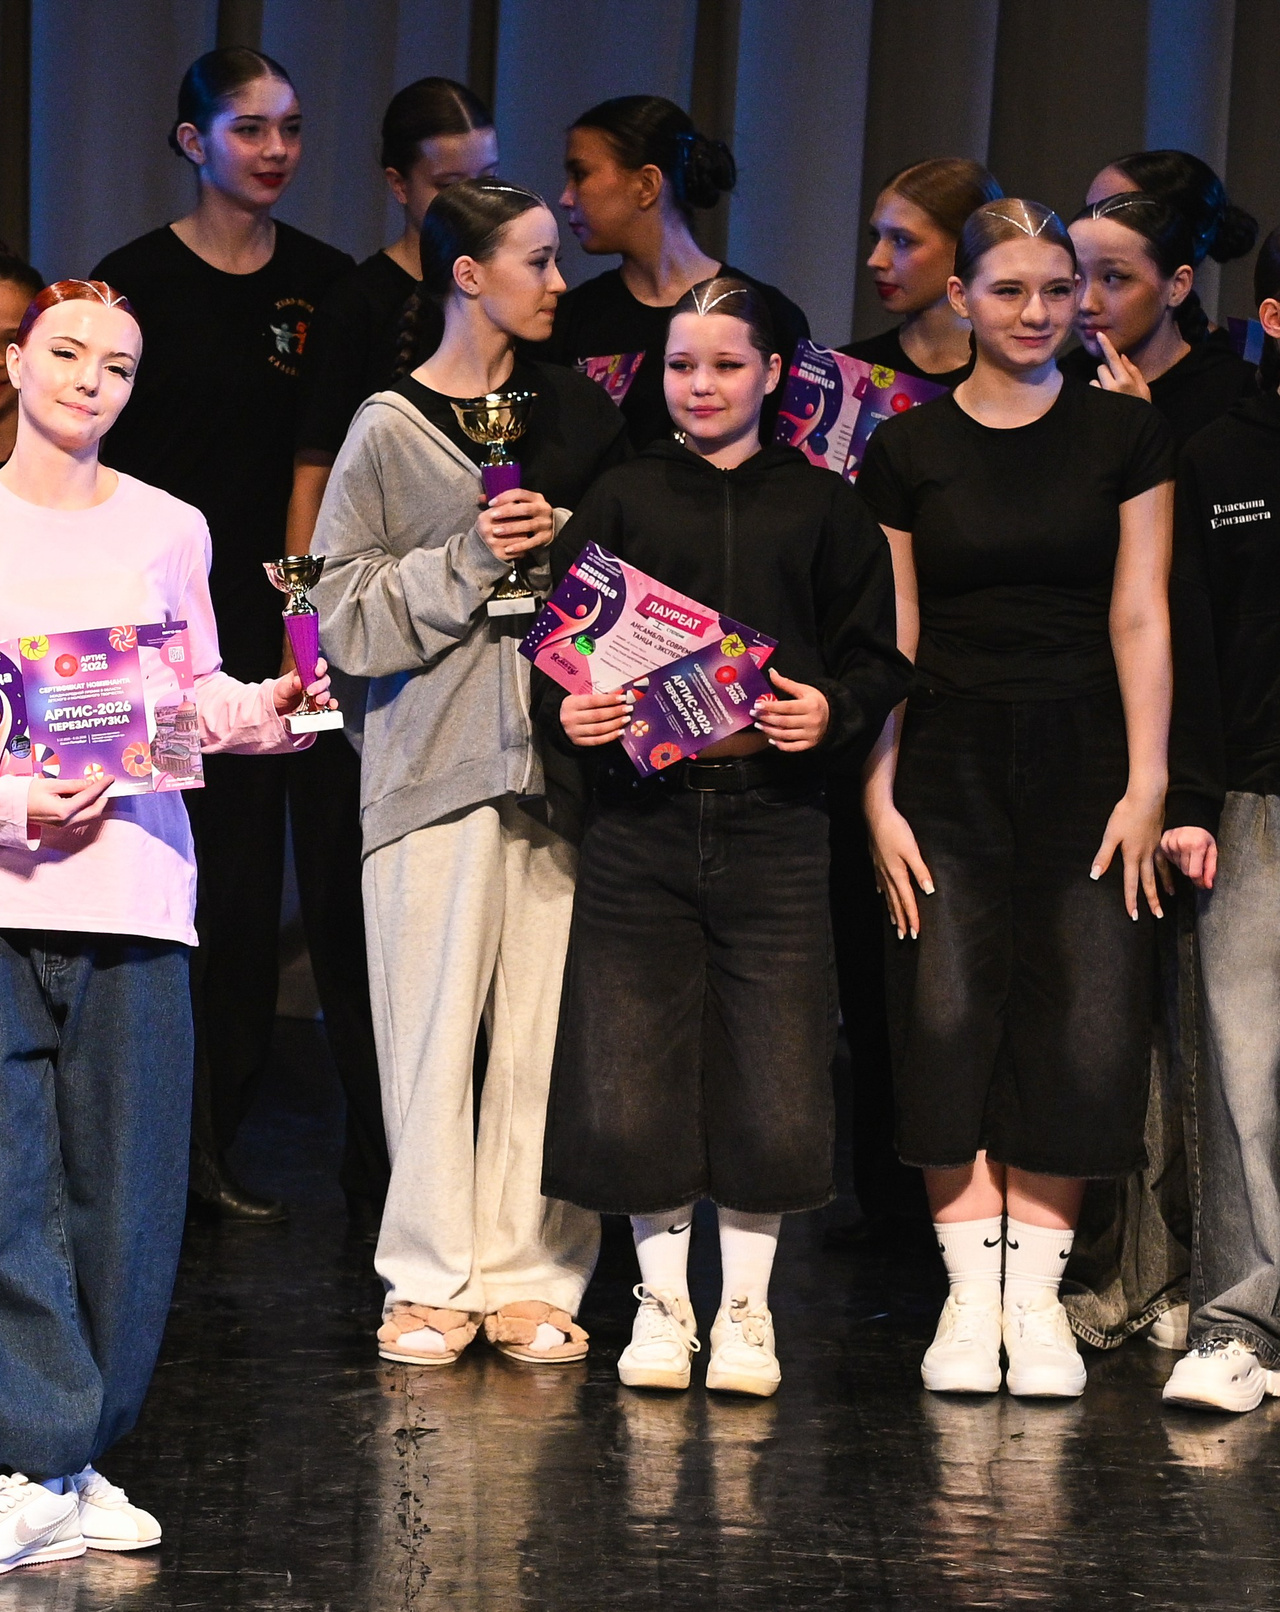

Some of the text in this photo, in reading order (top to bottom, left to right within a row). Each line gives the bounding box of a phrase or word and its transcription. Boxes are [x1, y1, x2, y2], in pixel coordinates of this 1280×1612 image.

[798, 368, 835, 390] танца
[1213, 499, 1265, 515] Власкина
[1210, 510, 1271, 530] Елизавета
[581, 562, 610, 583] магия
[576, 568, 618, 599] танца
[646, 601, 702, 630] ЛАУРЕАТ
[630, 621, 665, 643] АНСАМБЛЬ
[632, 631, 653, 647] ТАНЦА
[80, 653, 107, 663] АРТИС
[80, 660, 108, 672] 2026
[725, 684, 741, 705] 2026
[733, 682, 748, 701] АРТИС
[44, 701, 132, 721] АРТИС-2026
[662, 680, 701, 738] ПЕРЕЗАГРУЗКА
[671, 675, 714, 735] АРТИС-2026
[49, 714, 130, 732] ПЕРЕЗАГРУЗКА
